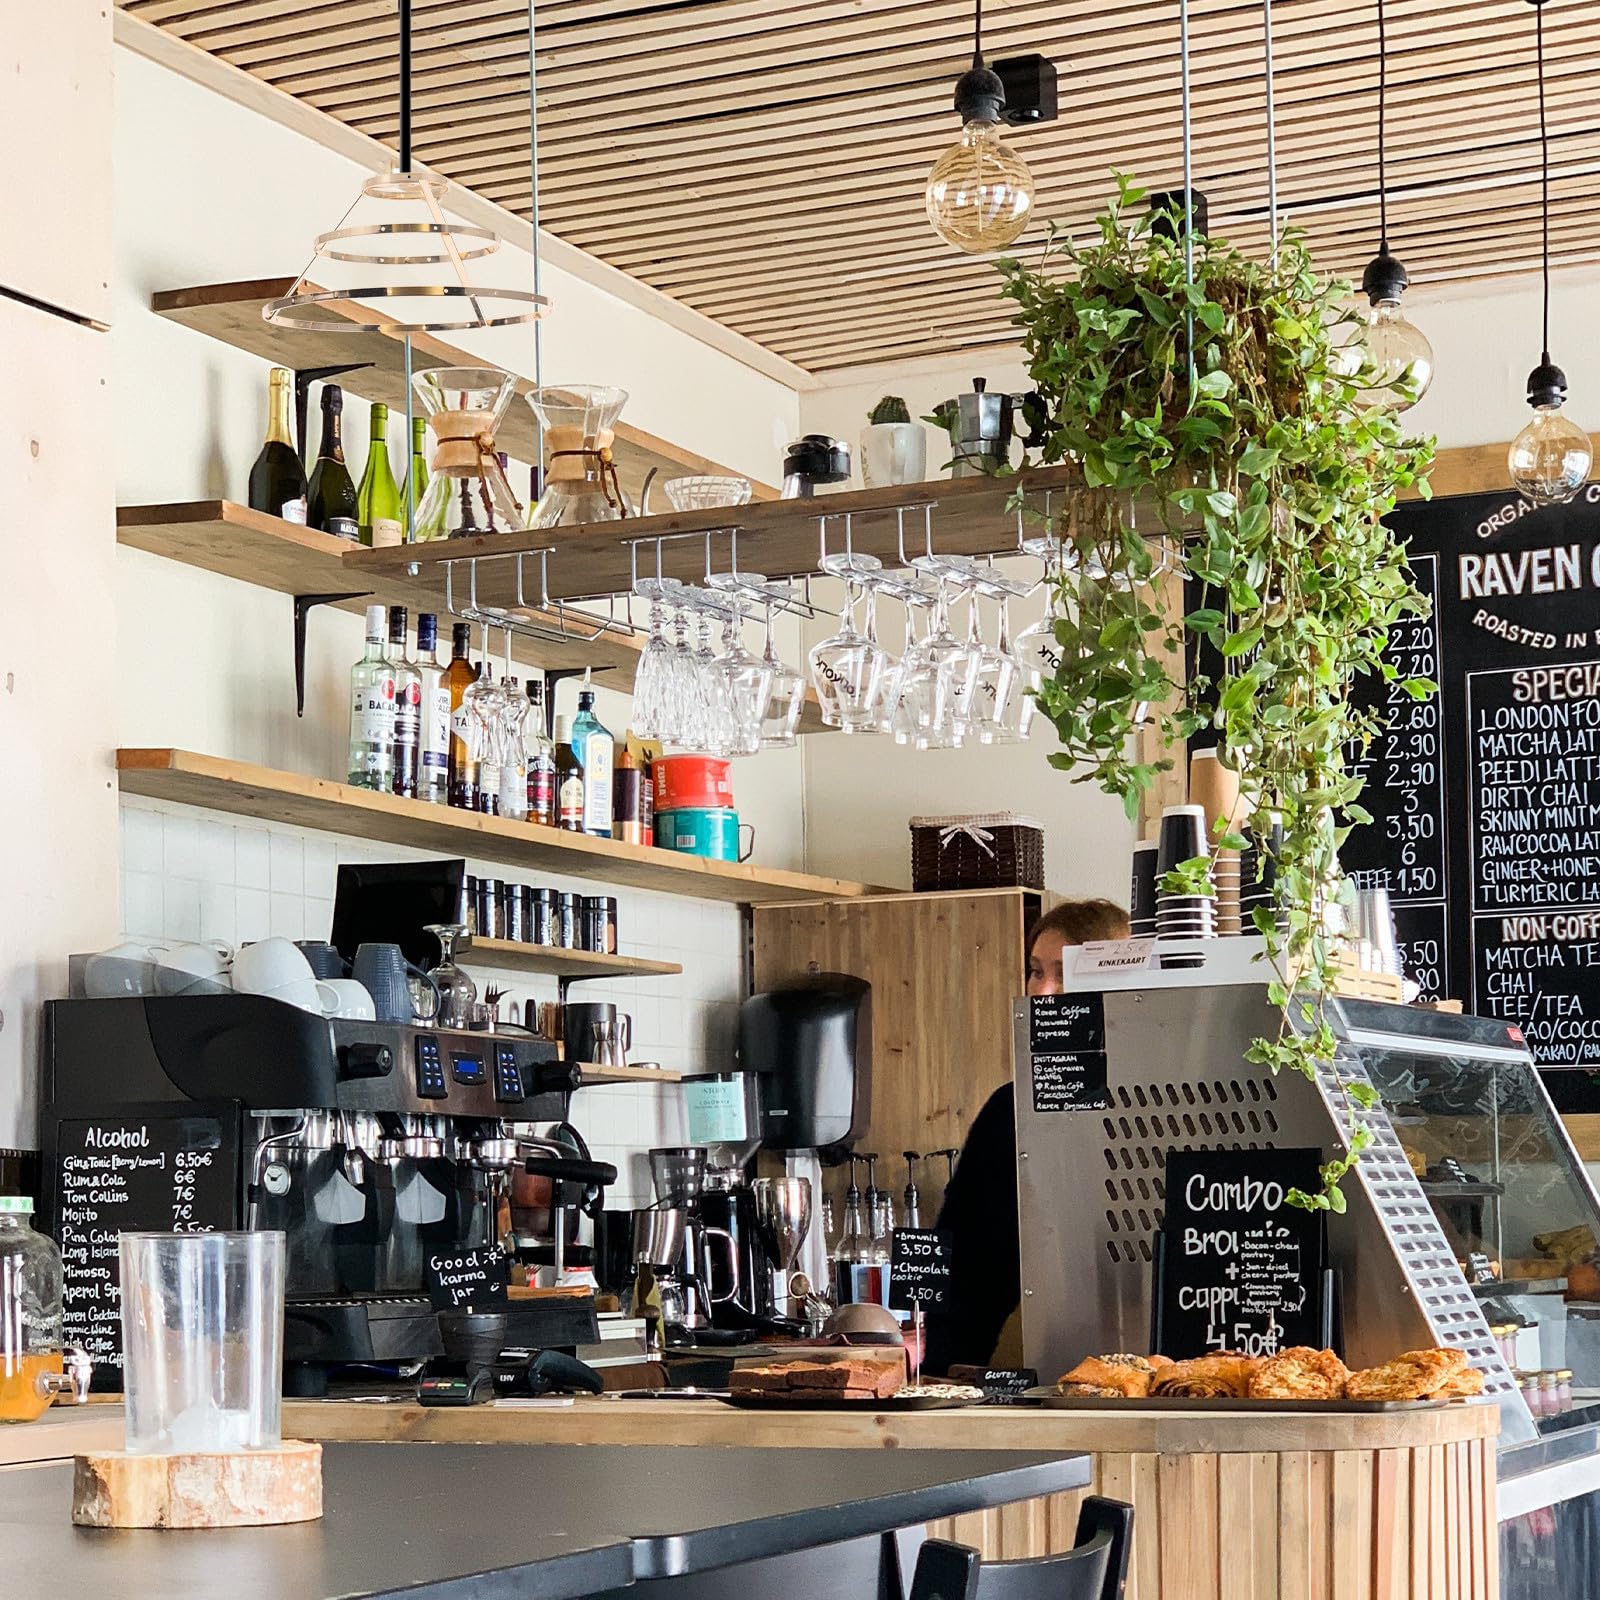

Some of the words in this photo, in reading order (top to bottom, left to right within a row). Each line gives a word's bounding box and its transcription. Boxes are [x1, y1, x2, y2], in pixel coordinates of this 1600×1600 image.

[1459, 543, 1582, 600] RAVEN
[1388, 626, 1434, 652] 2,20
[1473, 608, 1557, 650] ROASTED
[1565, 632, 1587, 649] IN
[1388, 653, 1434, 680] 2,20
[1386, 705, 1437, 731] 2,60
[1477, 702, 1569, 733] LONDON
[1385, 733, 1436, 761] 2,90
[1479, 730, 1562, 759] MATCHA
[1562, 729, 1600, 756] LAT
[1385, 761, 1435, 788] 2,90
[1400, 788, 1419, 813] 3
[1481, 785, 1537, 809] DIRTY
[1540, 782, 1588, 807] CHAI
[1386, 813, 1434, 841] 3,50
[1480, 808, 1542, 832] SKINNY
[1545, 805, 1587, 829] MINT
[1401, 841, 1417, 866] 6
[1397, 866, 1437, 895] 1,50
[1480, 882, 1580, 904] TURMERIC
[1098, 956, 1146, 967] KINKEKAART
[1485, 944, 1566, 971] MATCHA
[1487, 971, 1534, 995] CHAI
[1487, 990, 1584, 1020] TEE/TEA
[84, 1126, 150, 1149] Alcohol
[175, 1152, 213, 1168] 6,50€
[174, 1170, 196, 1184] 6€
[62, 1190, 88, 1204] Tom
[89, 1188, 129, 1203] Collins
[173, 1186, 196, 1202] 7€
[1185, 1173, 1284, 1212] Combo
[62, 1207, 99, 1226] Mojito
[172, 1204, 193, 1220] 7€
[900, 1232, 939, 1242] Brownie
[61, 1243, 89, 1265] Long
[430, 1251, 479, 1271] Good
[62, 1263, 111, 1279] Mimosa
[439, 1270, 487, 1287] karma
[891, 1272, 923, 1281] cookie
[899, 1262, 950, 1275] Chocolate
[62, 1282, 101, 1304] Aperol
[451, 1287, 475, 1305] jar
[62, 1325, 90, 1339] rganic
[84, 1337, 115, 1353] Coffee
[984, 1370, 1018, 1380] GLUTEN
